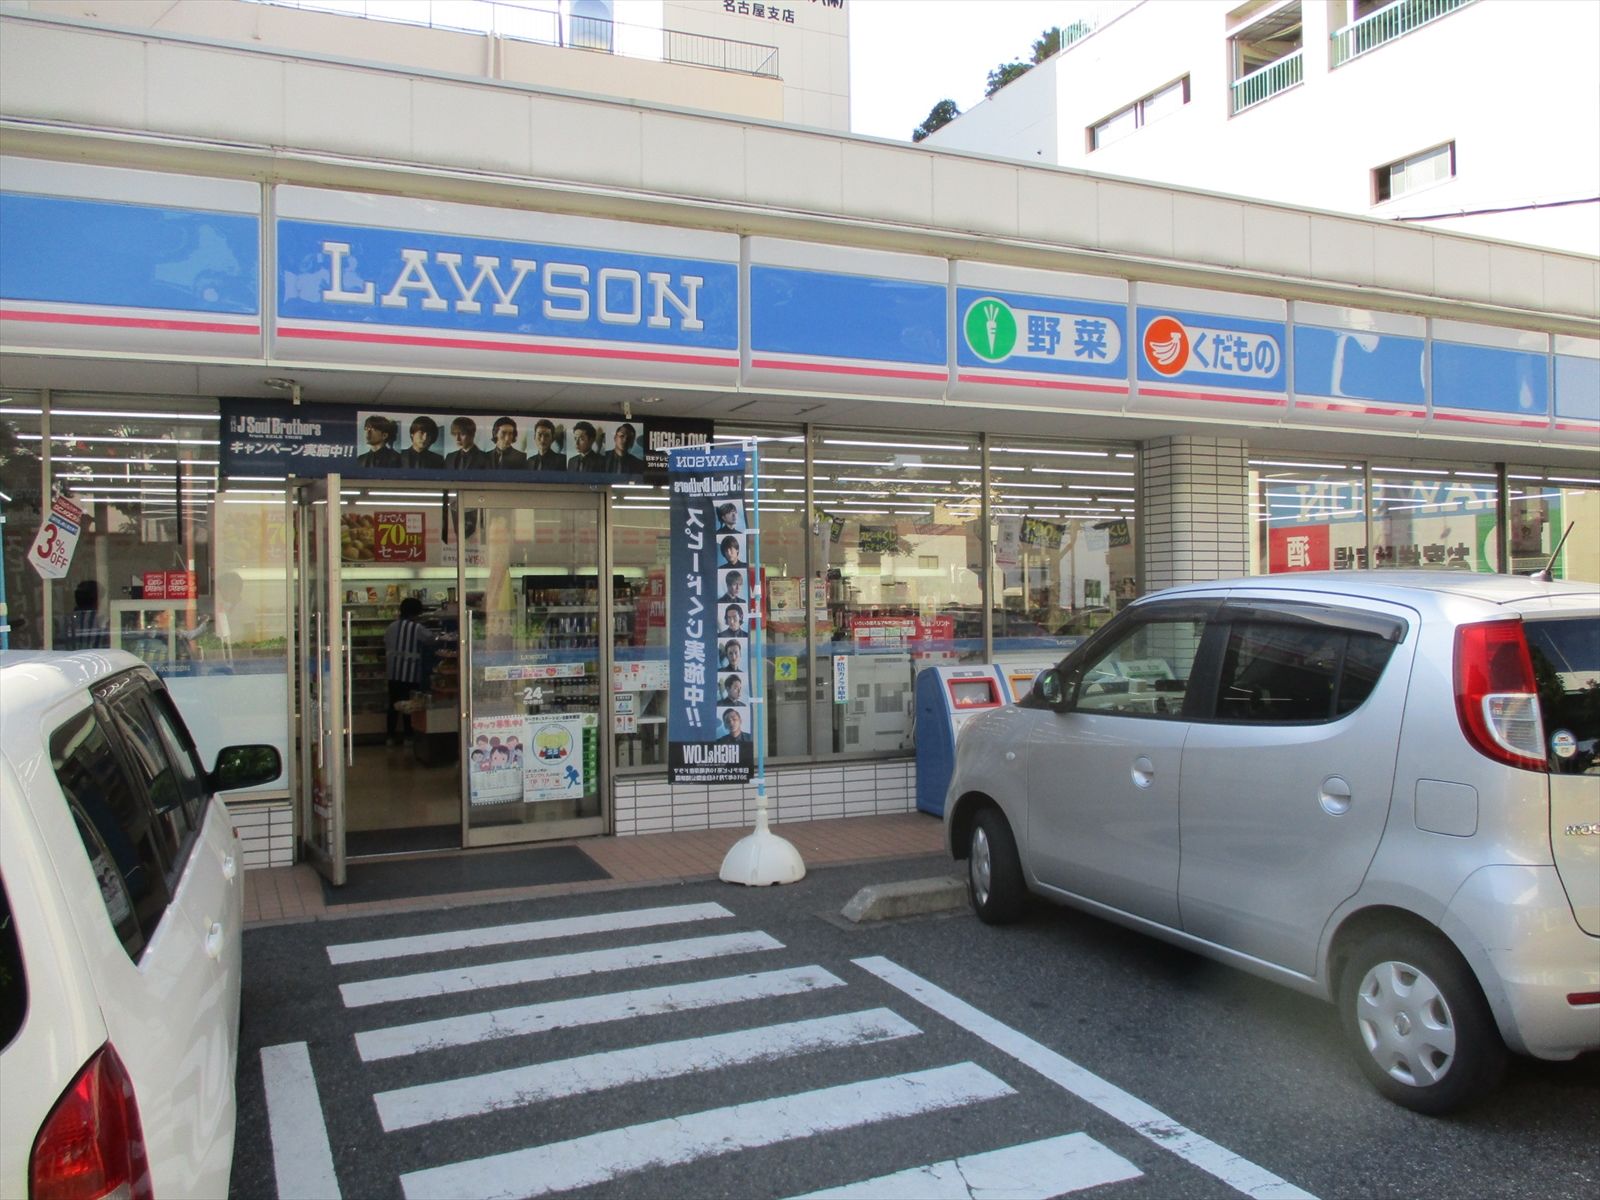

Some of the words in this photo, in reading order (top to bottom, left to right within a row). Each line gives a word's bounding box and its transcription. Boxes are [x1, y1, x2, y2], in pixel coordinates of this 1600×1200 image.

[723, 0, 795, 24] 名古屋支店
[322, 241, 704, 331] LAWSON
[1027, 315, 1107, 360] 野菜
[1192, 332, 1276, 374] くだもの
[247, 416, 271, 434] Soul
[272, 417, 322, 436] Brothers
[50, 552, 69, 569] OFF
[378, 545, 422, 558] セール
[523, 686, 543, 700] 24
